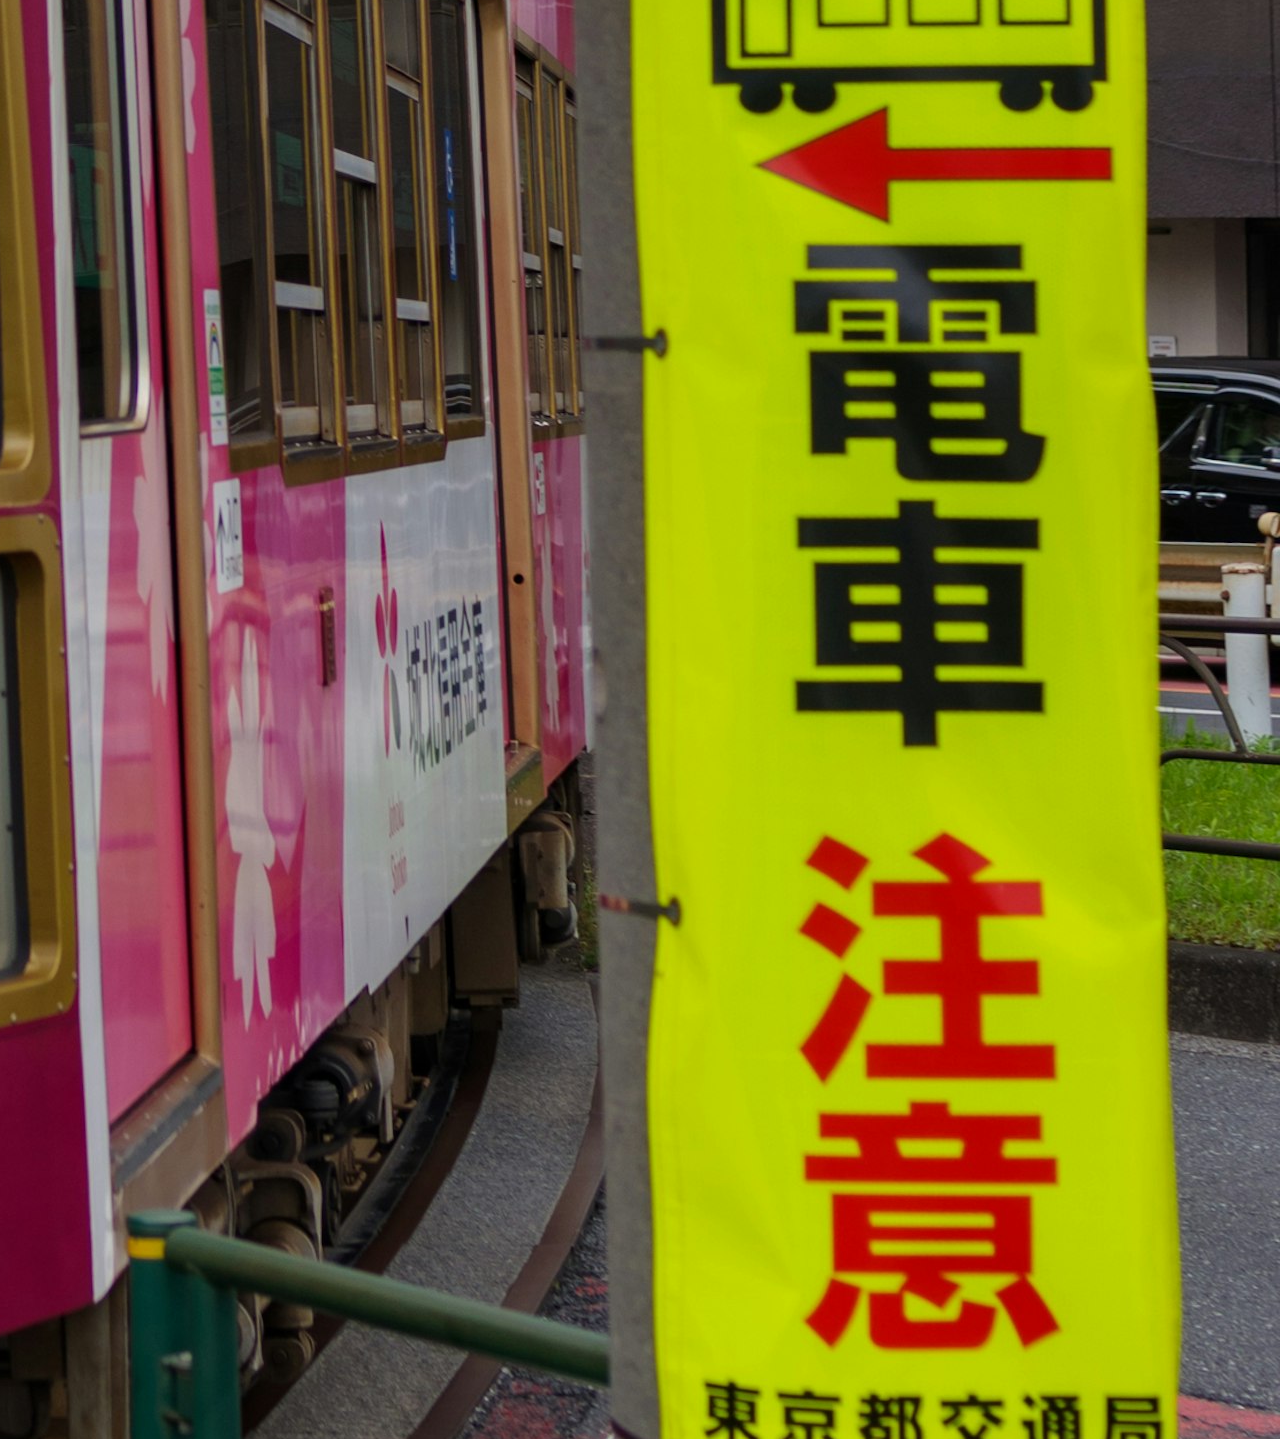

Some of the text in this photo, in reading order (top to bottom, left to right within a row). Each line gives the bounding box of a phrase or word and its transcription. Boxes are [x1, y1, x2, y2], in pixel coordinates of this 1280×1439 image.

[406, 593, 487, 779] 城北信用金庫
[793, 244, 1059, 1350] 電車 注意
